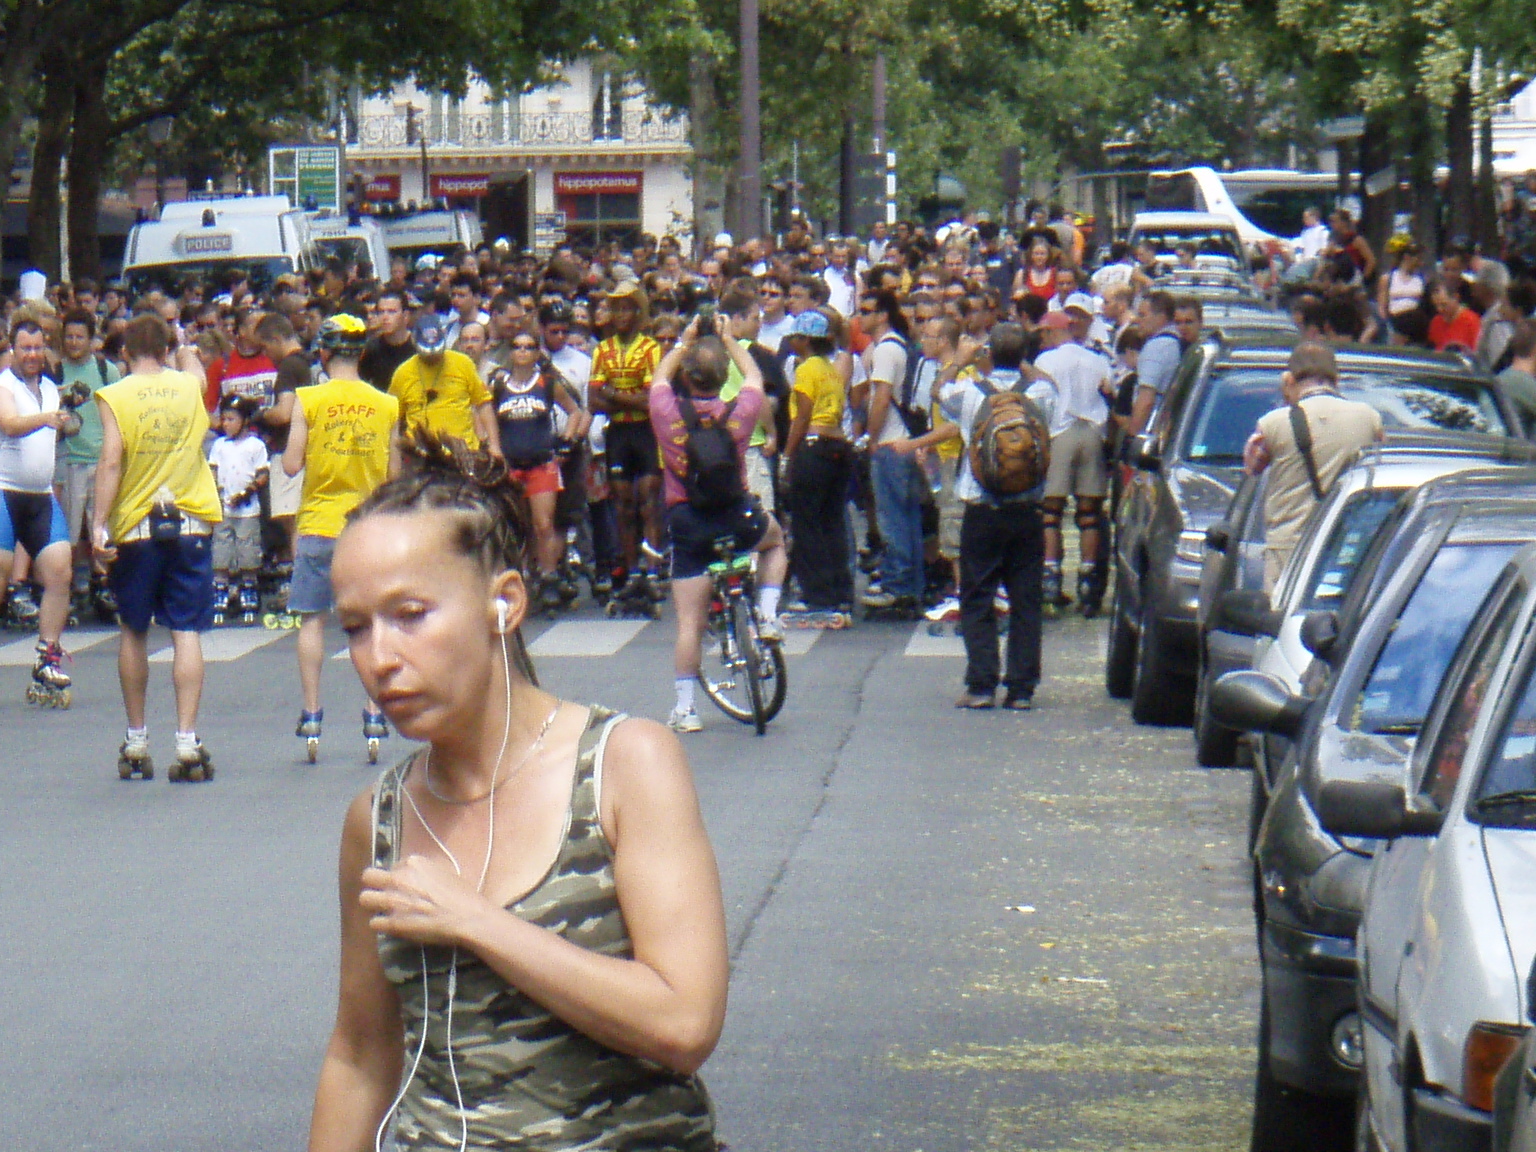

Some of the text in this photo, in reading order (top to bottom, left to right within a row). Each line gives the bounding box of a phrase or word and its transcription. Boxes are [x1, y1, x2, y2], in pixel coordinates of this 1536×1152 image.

[439, 178, 487, 192] hippopot
[559, 176, 637, 190] hippopotamus
[187, 238, 232, 251] POLICE
[137, 388, 179, 401] STAFF
[327, 403, 376, 418] STAFF
